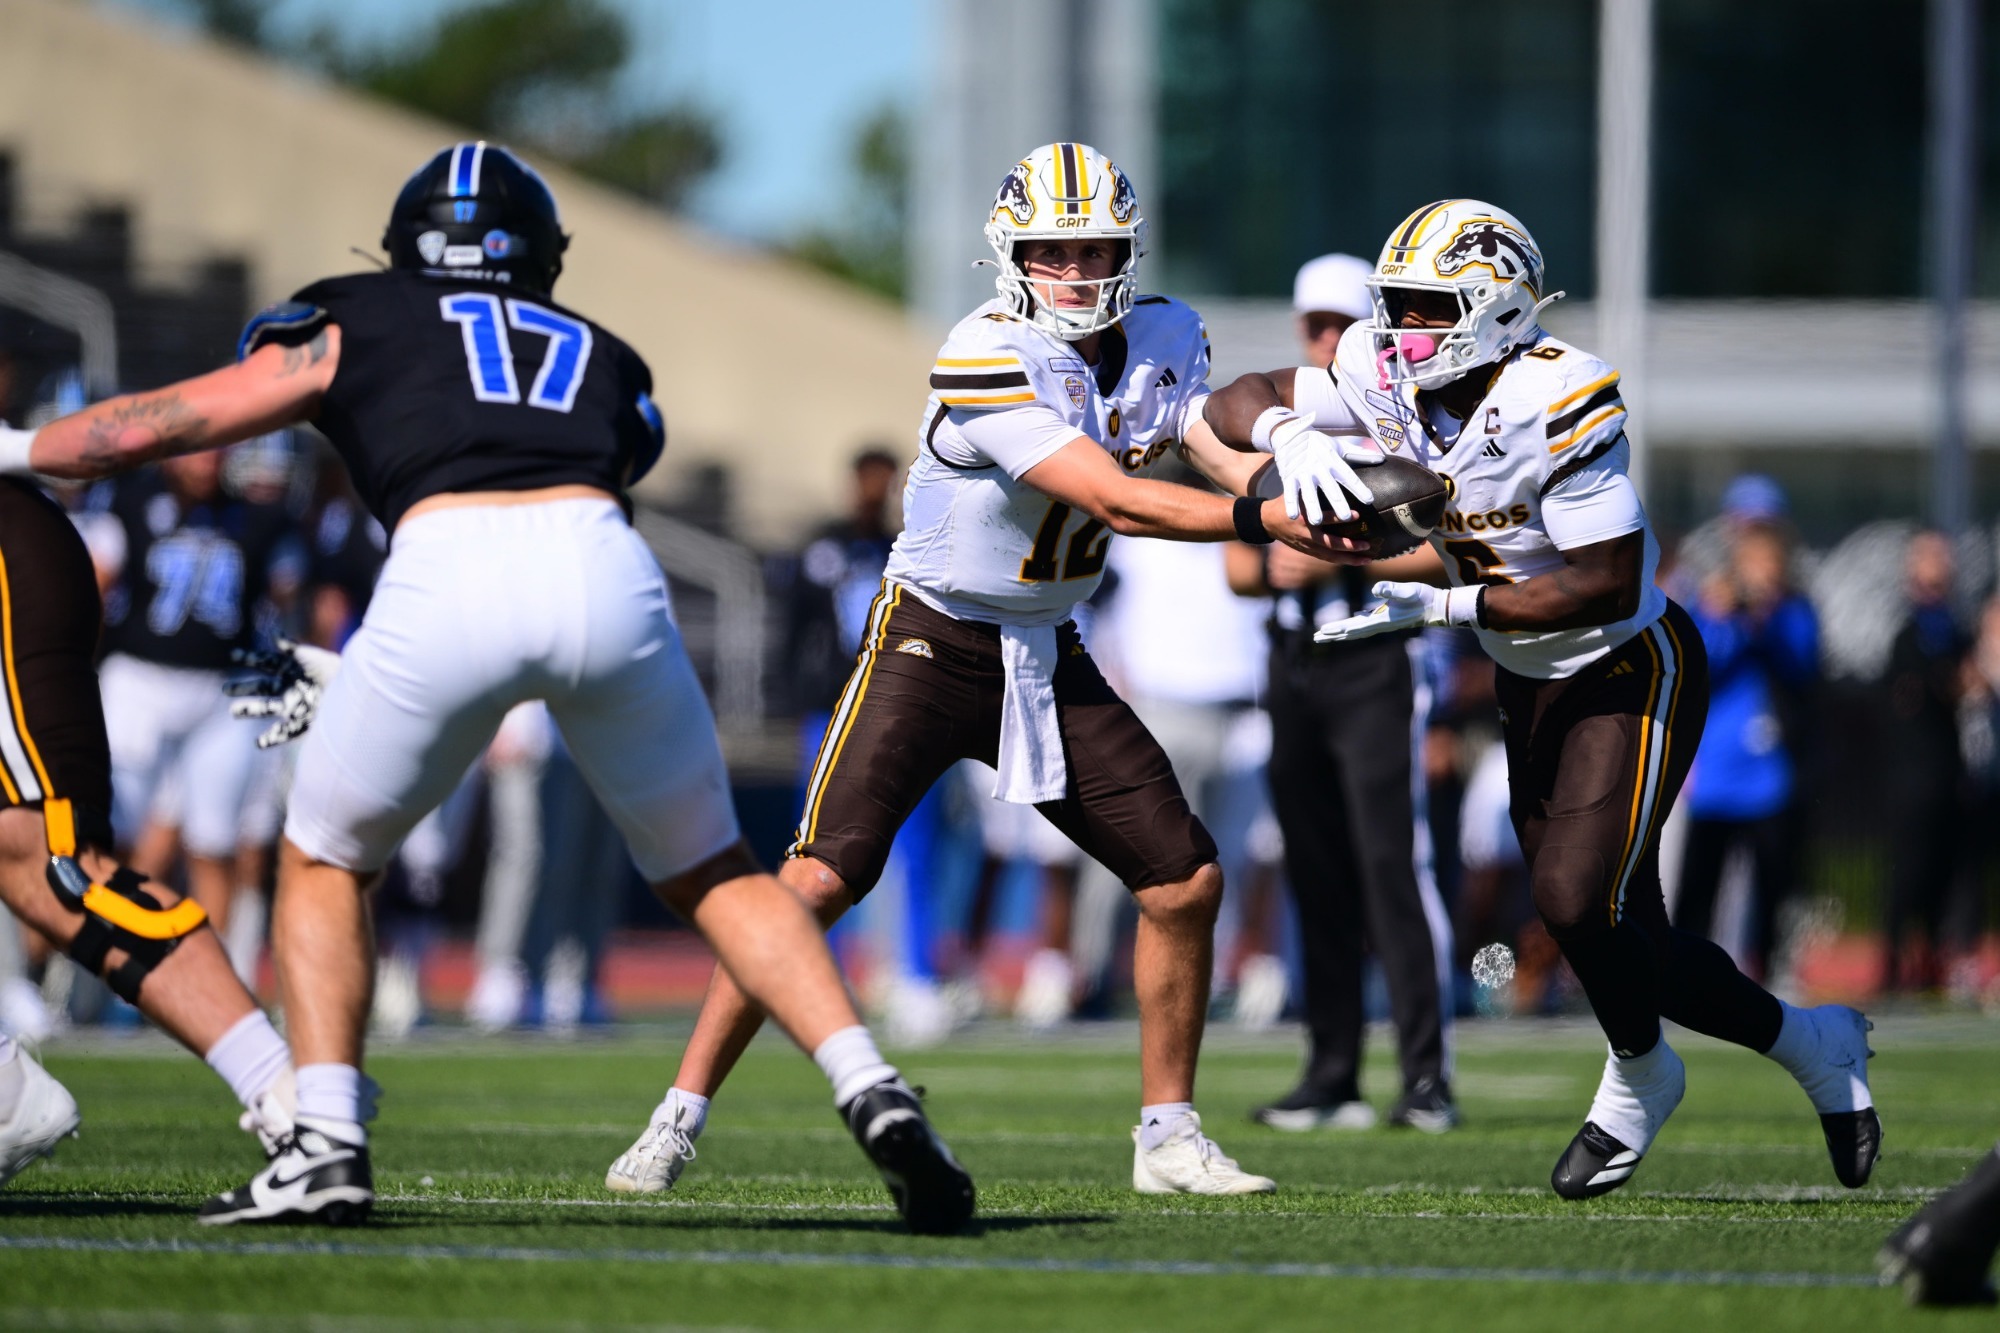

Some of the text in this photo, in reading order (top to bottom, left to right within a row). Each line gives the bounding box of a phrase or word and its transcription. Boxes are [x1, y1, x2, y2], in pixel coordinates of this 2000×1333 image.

[1056, 217, 1090, 228] GRIT
[1381, 264, 1407, 275] GRIT
[439, 291, 593, 414] 17
[1379, 425, 1404, 440] MAC
[1484, 407, 1501, 434] C
[1436, 503, 1531, 533] NCOS
[1019, 498, 1110, 582] 12
